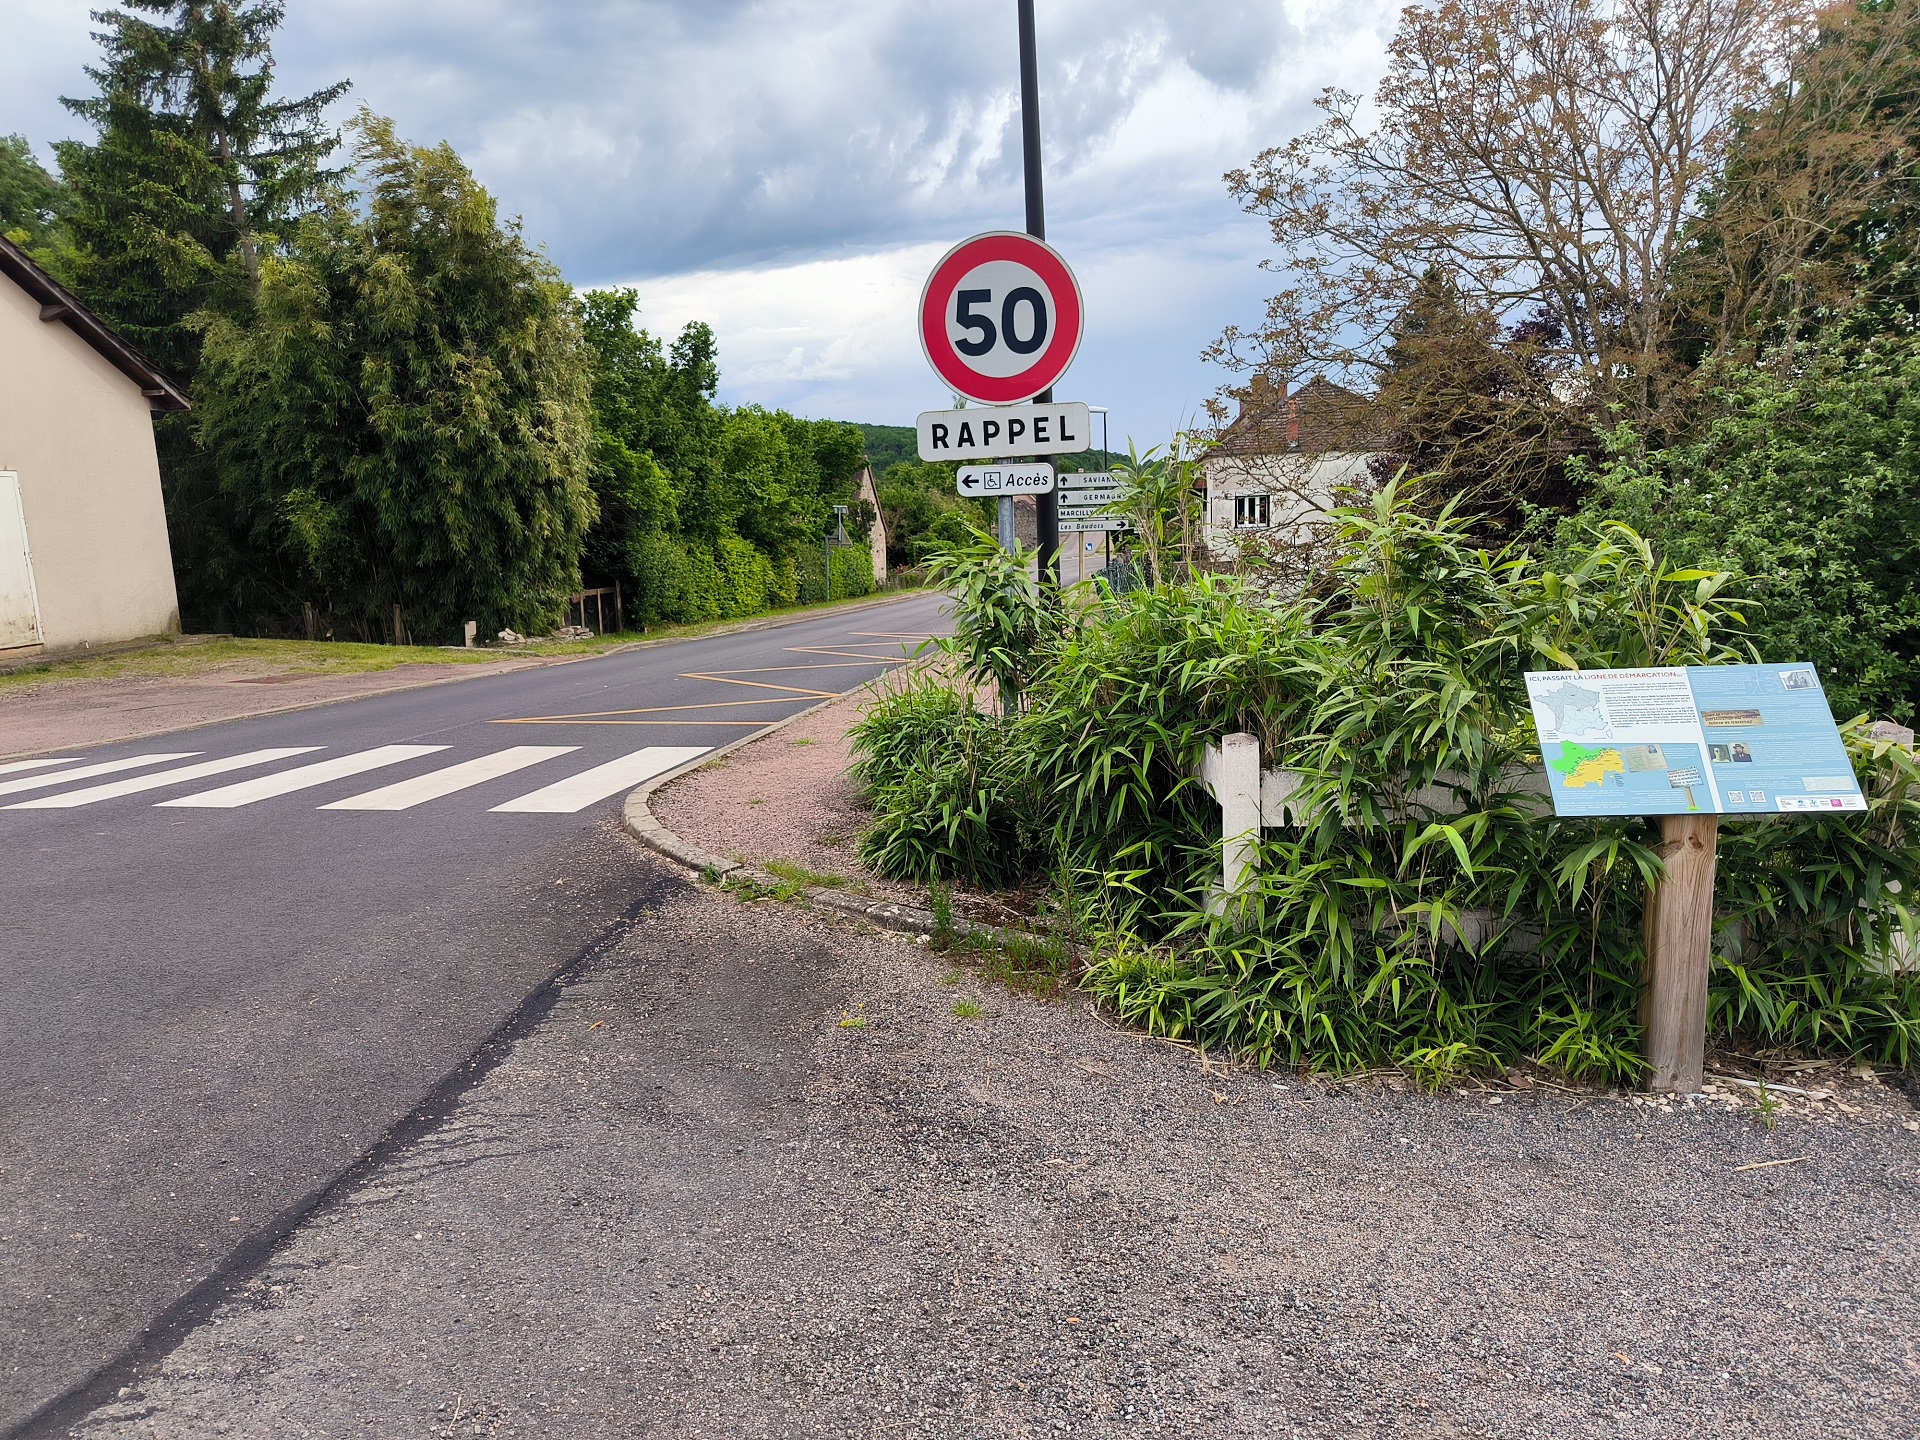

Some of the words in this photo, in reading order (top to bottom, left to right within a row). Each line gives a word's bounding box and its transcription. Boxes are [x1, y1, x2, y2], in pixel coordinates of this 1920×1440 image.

[955, 287, 1048, 357] 50
[932, 415, 1075, 449] RAPPEL
[1005, 472, 1049, 487] Accès
